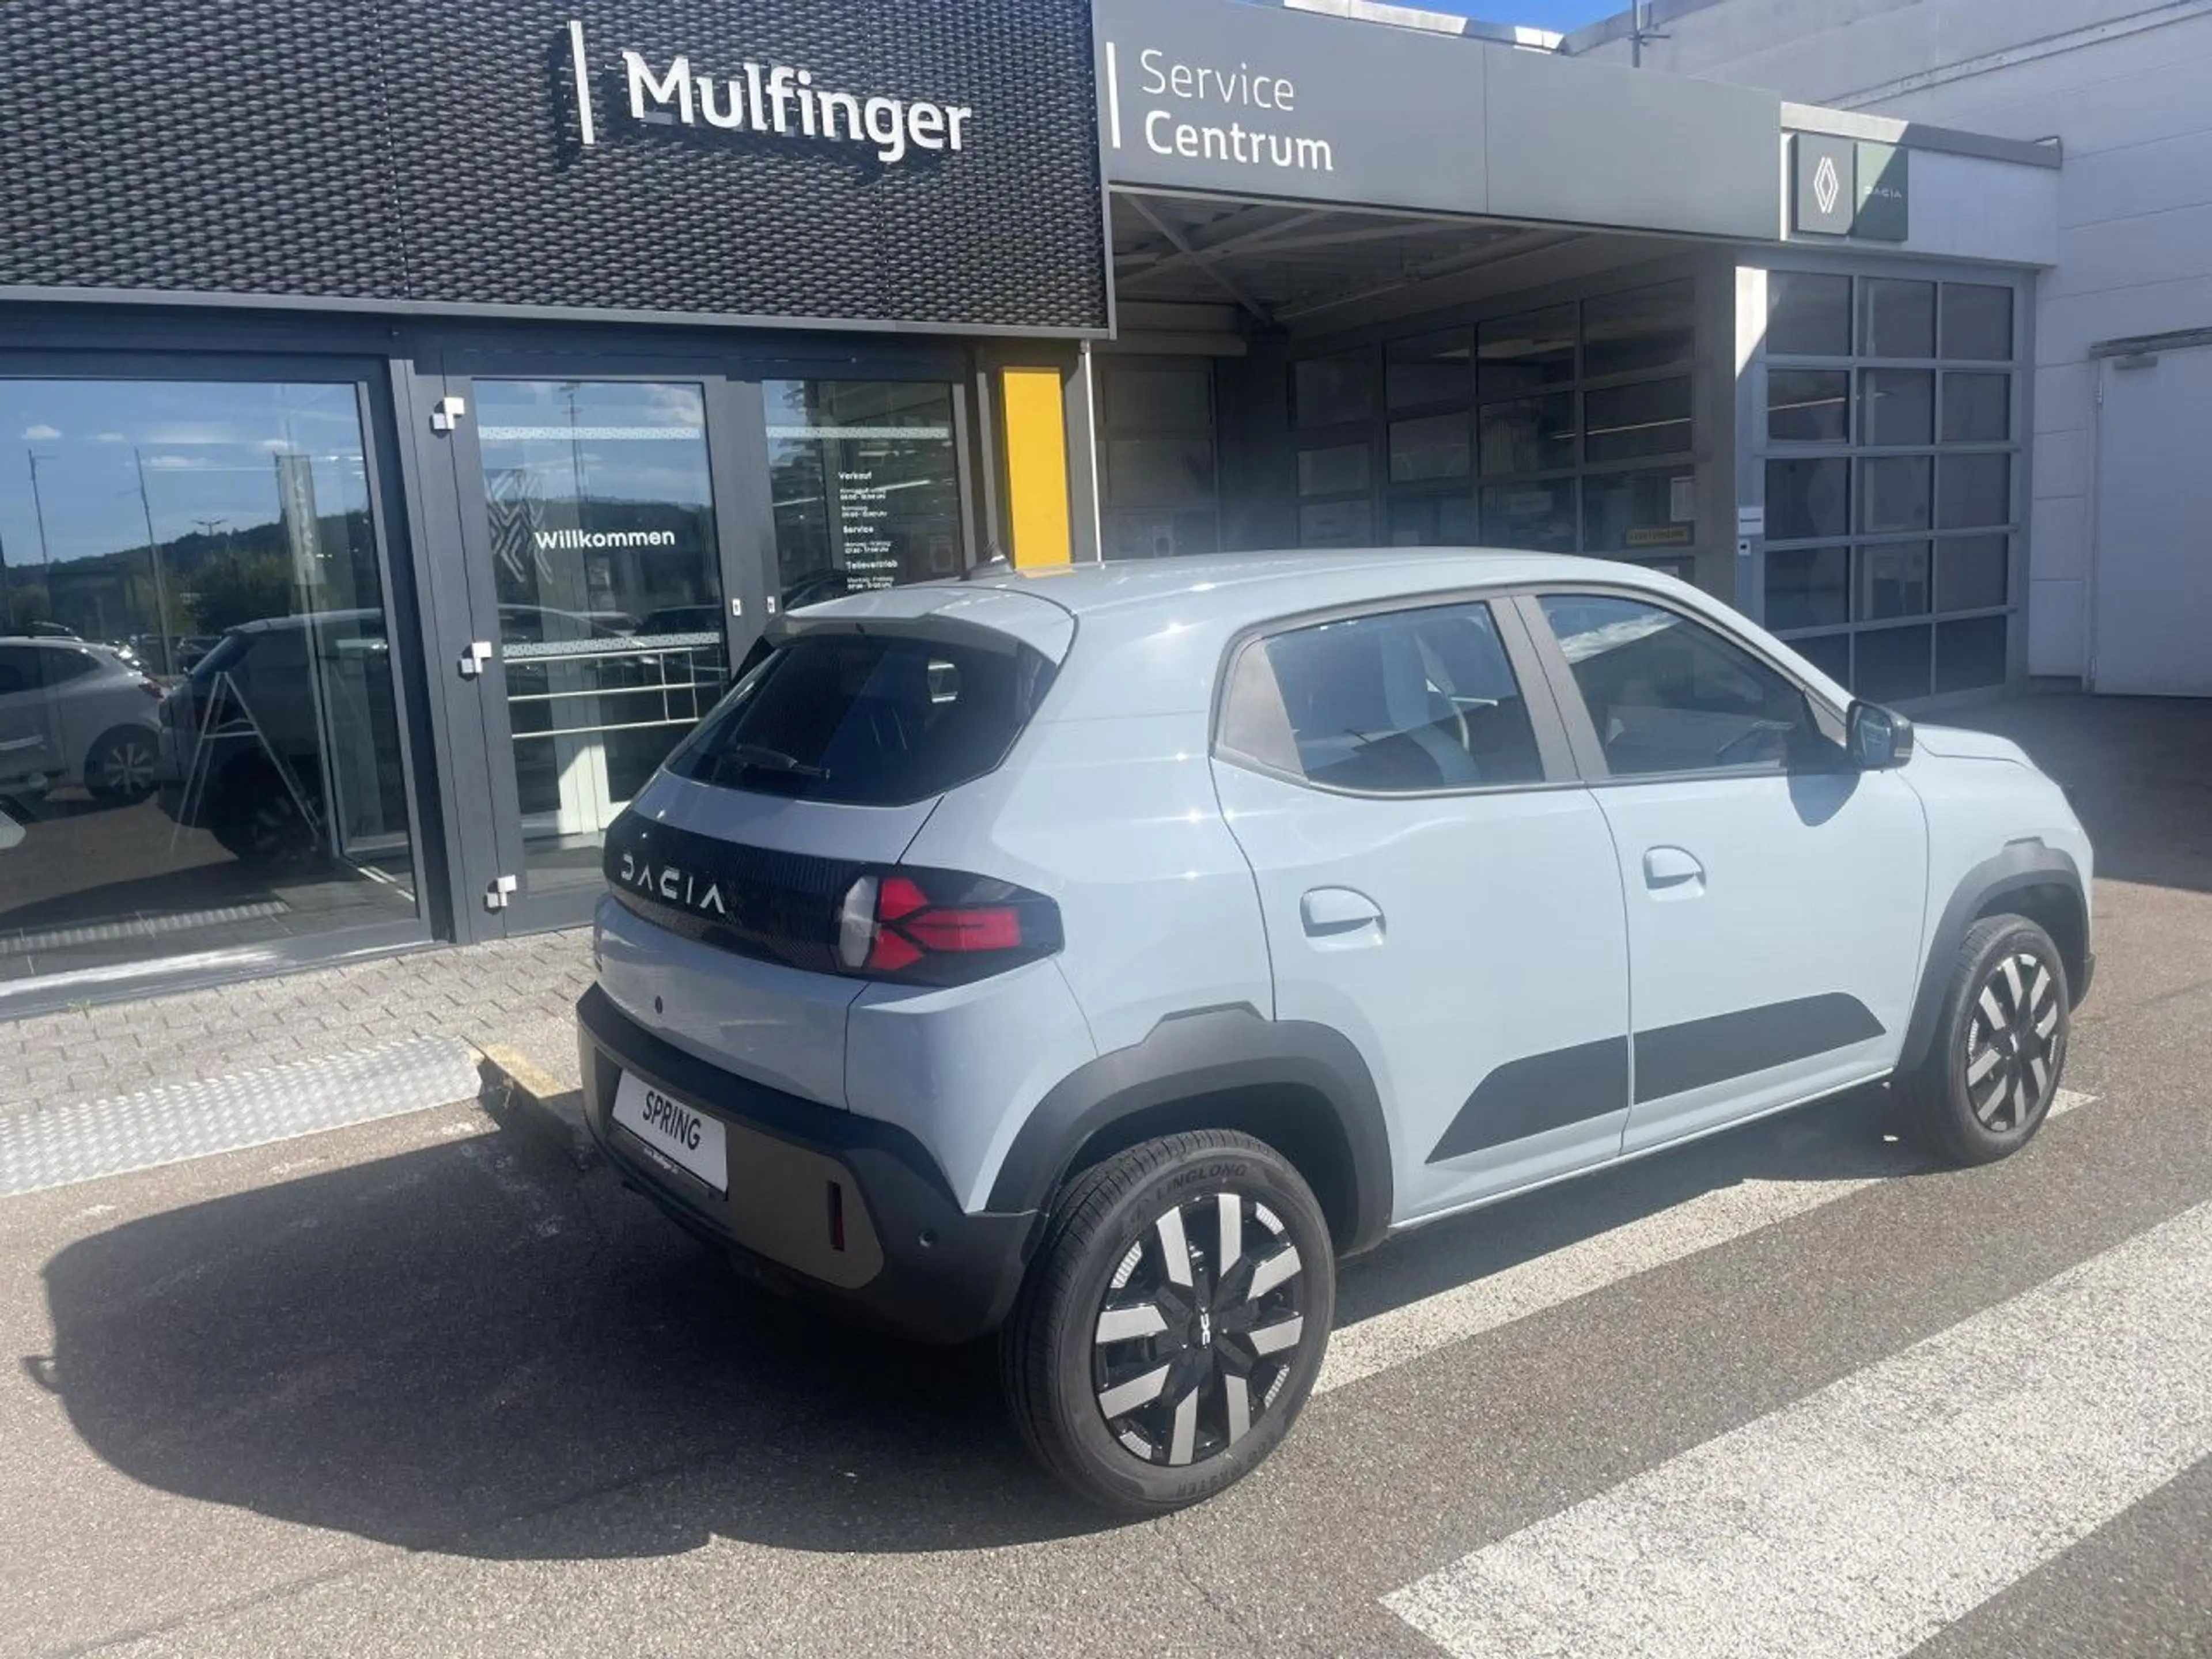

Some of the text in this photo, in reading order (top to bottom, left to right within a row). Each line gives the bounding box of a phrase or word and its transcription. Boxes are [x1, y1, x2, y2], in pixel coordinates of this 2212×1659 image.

[622, 50, 972, 163] Mulfinger
[1140, 48, 1294, 111] Service
[1145, 110, 1334, 171] Centrum
[838, 471, 872, 480] Verkauf
[535, 529, 675, 549] Willkommen
[843, 525, 874, 533] Service
[620, 853, 725, 914] DACIA
[642, 1090, 702, 1150] SPRING
[1156, 1162, 1248, 1200] LINGLONG
